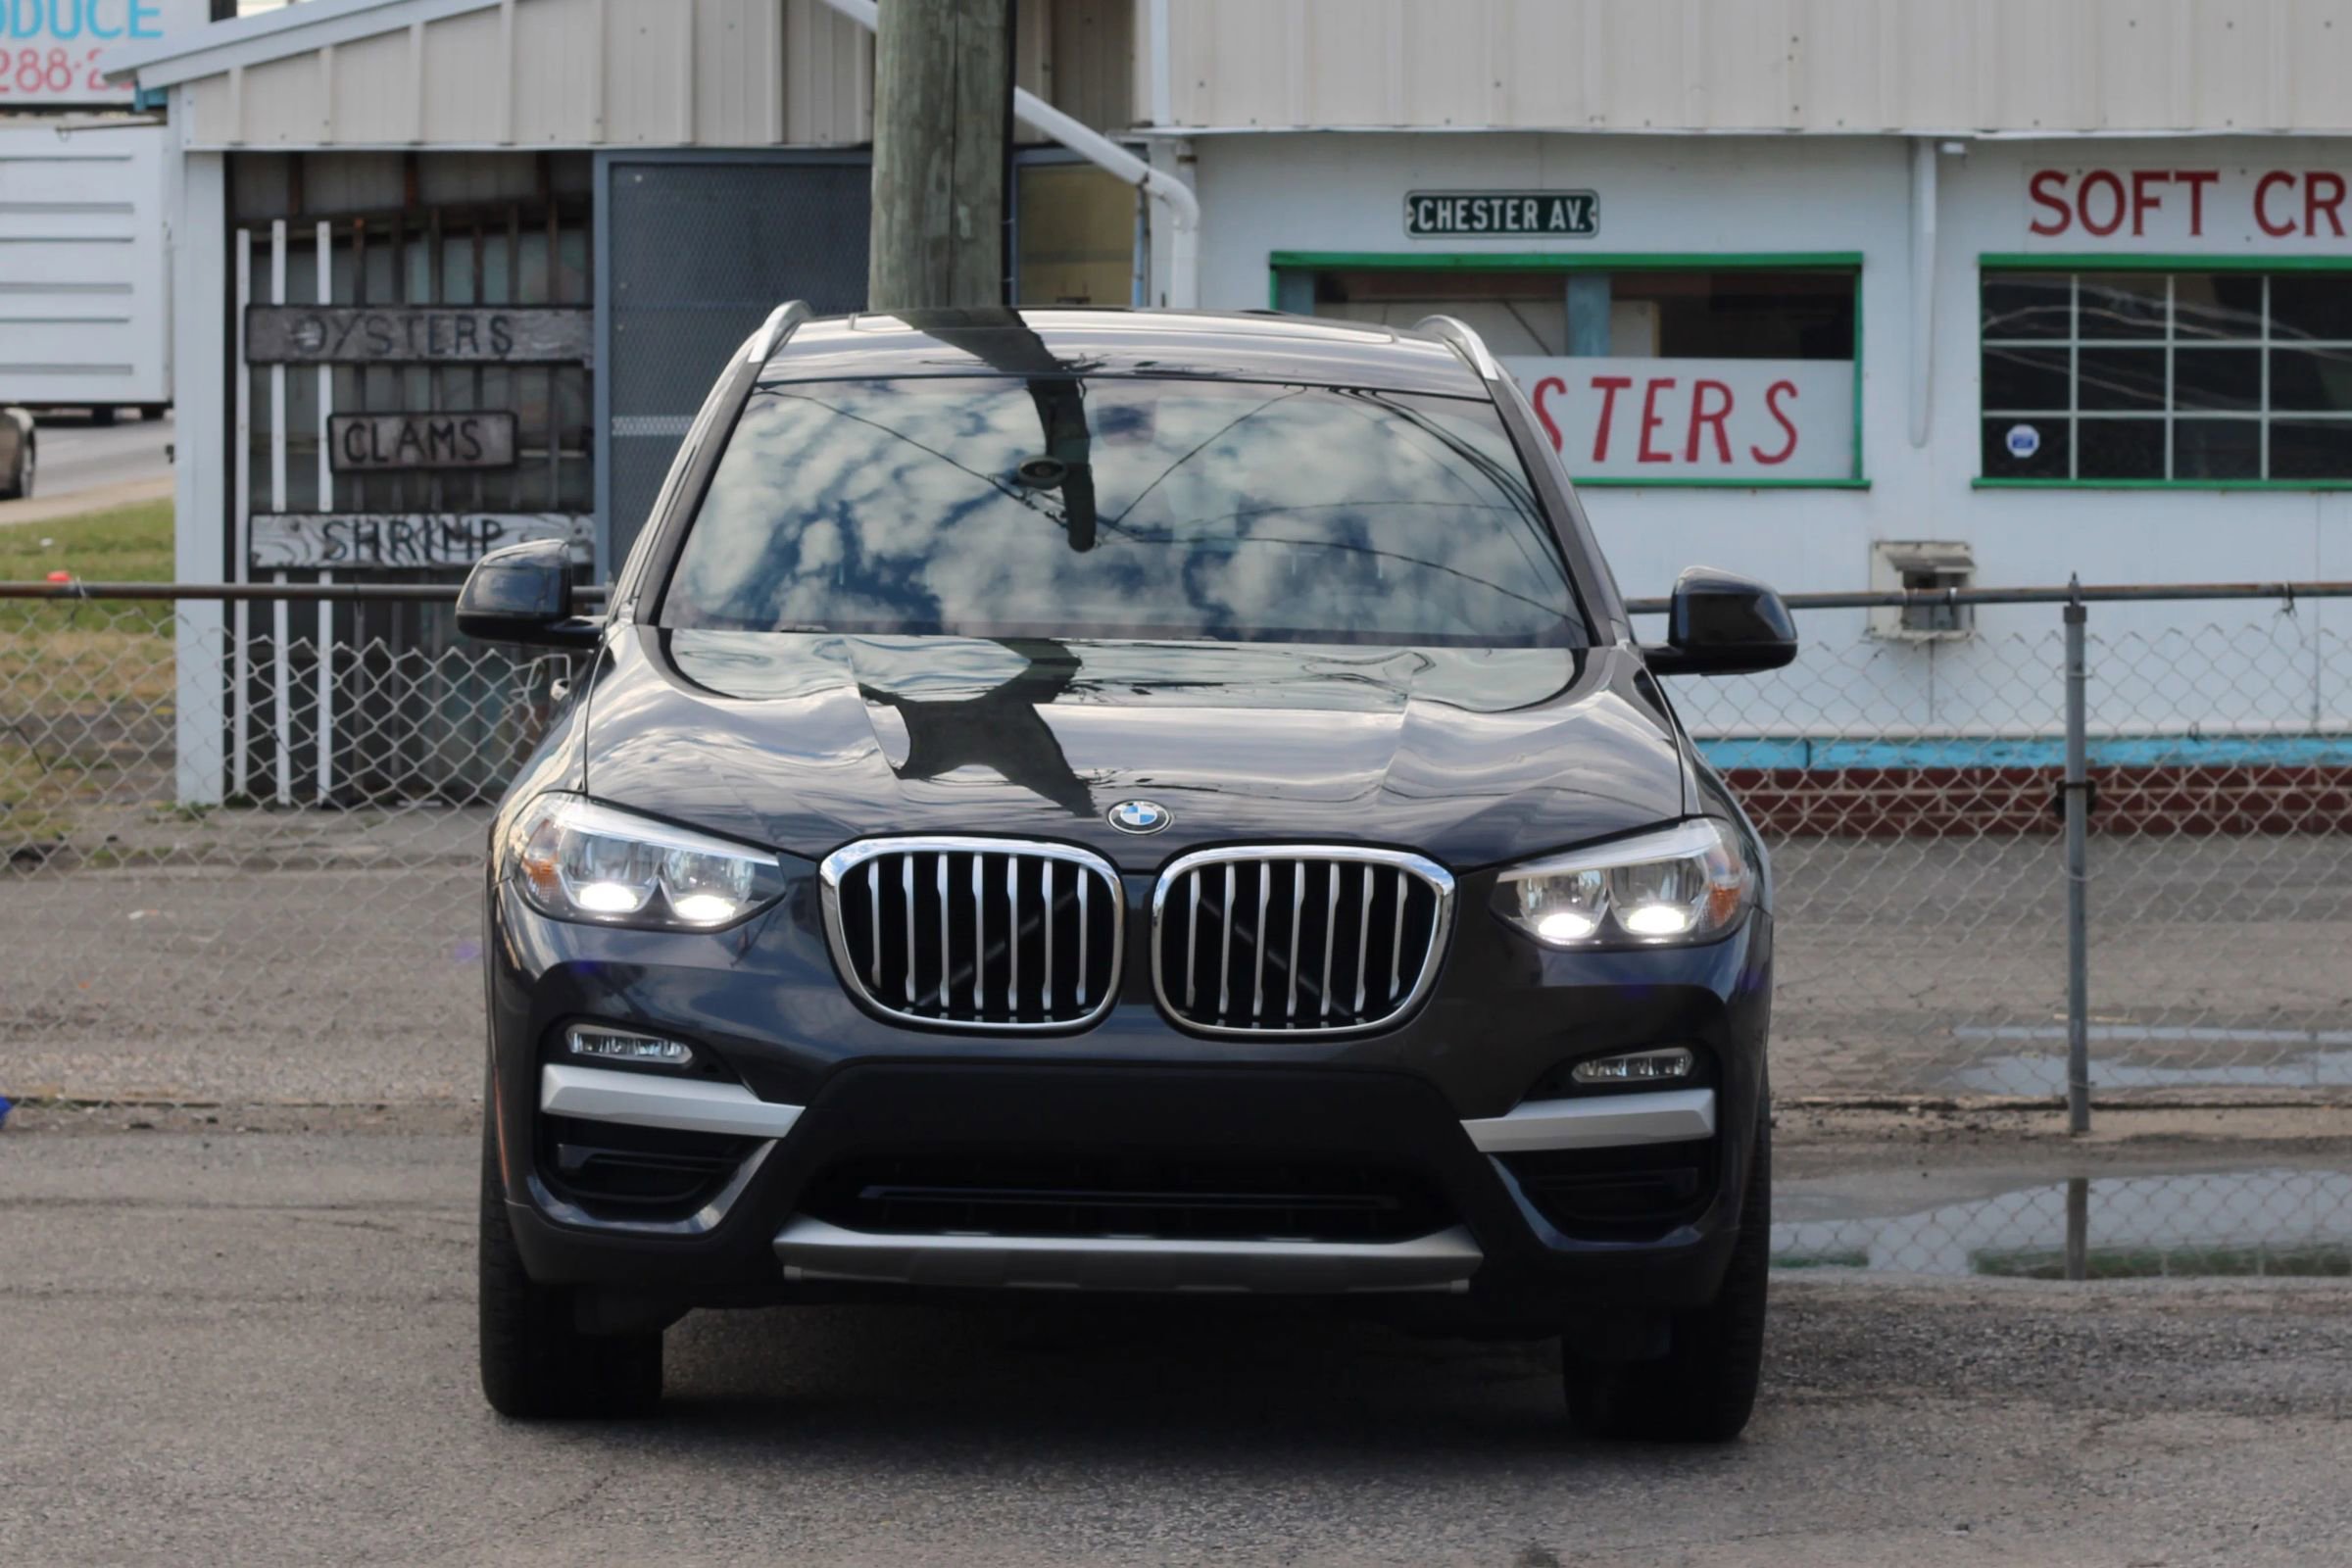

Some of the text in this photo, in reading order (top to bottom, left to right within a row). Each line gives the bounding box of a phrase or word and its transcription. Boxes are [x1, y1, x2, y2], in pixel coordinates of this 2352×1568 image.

[0, 0, 164, 40] DUCE
[1418, 199, 1585, 231] CHESTER AV.
[2029, 169, 2220, 237] SOFT
[294, 315, 514, 355] OYSTERS
[344, 418, 483, 464] CLAMS
[322, 518, 503, 562] SHRIMP
